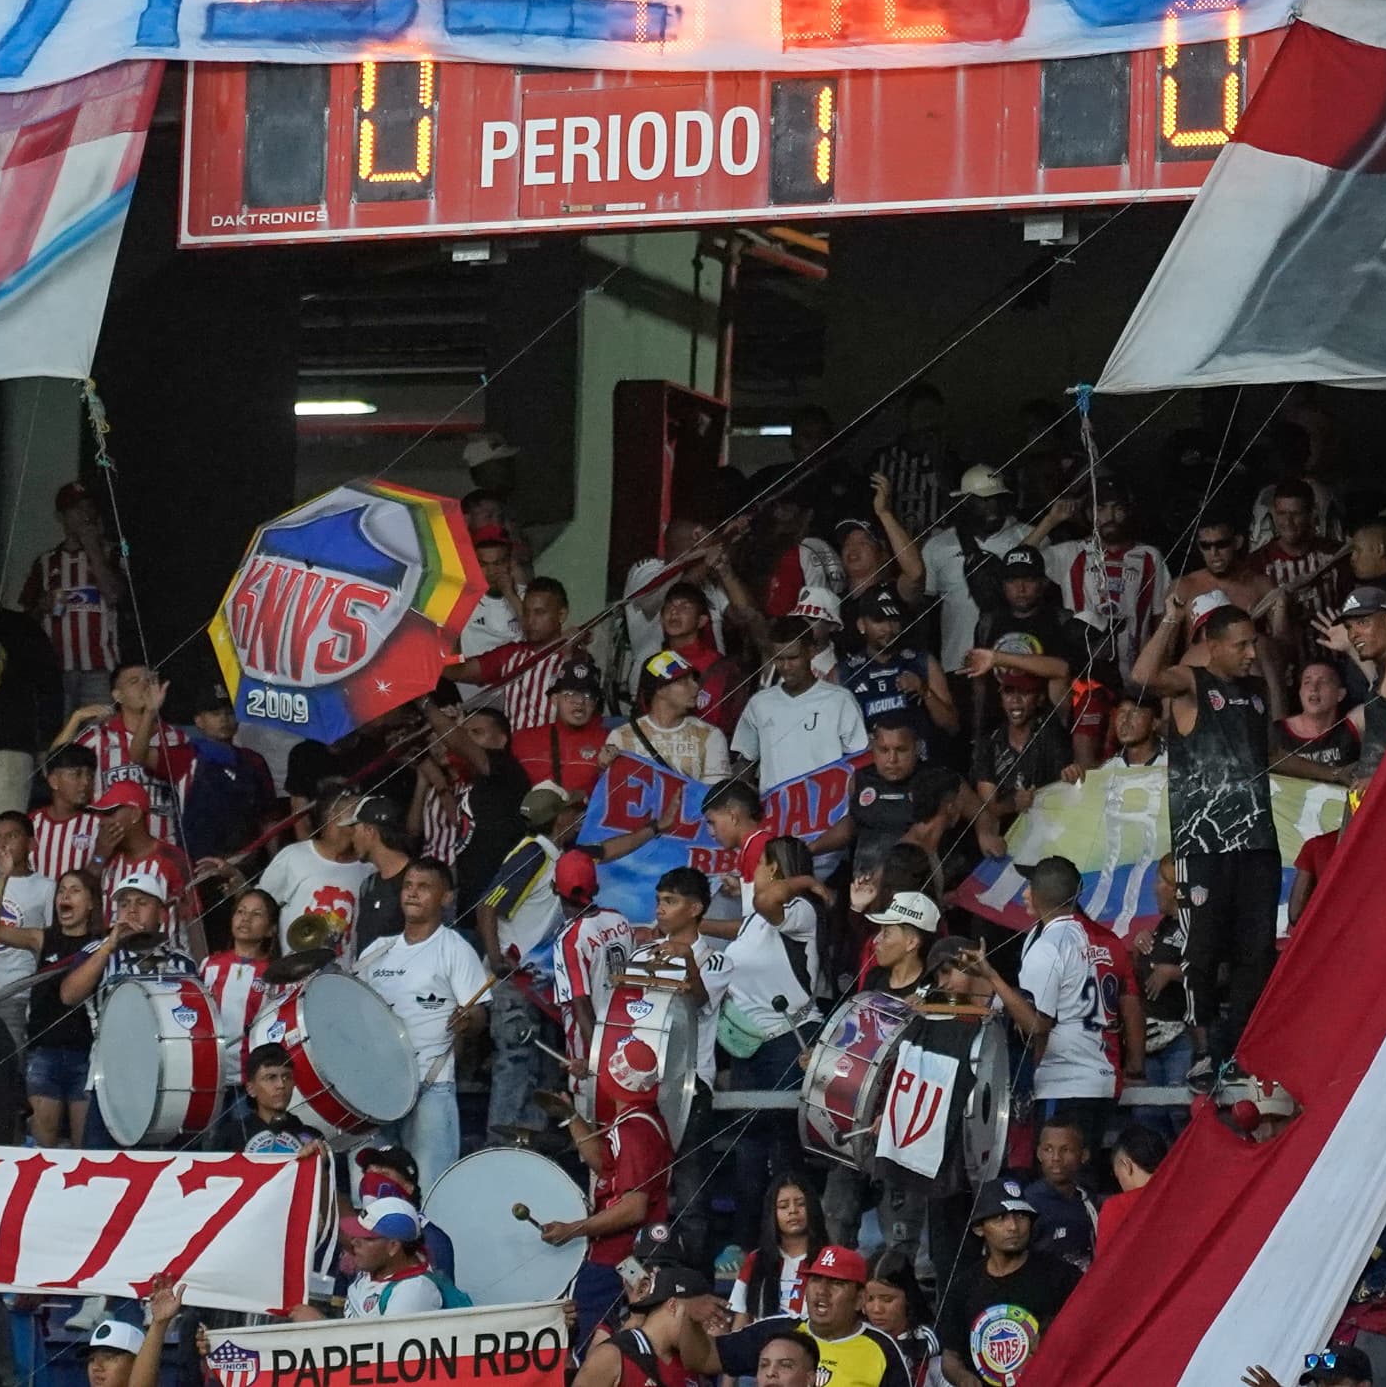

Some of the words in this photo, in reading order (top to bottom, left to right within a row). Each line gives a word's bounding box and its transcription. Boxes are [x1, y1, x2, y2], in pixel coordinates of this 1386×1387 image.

[481, 105, 761, 190] PERIODO
[816, 85, 833, 186] 1
[210, 210, 329, 228] DAKTRONICS
[231, 554, 393, 679] KNVS
[245, 685, 311, 725] 2009
[804, 711, 820, 732] J
[868, 695, 905, 716] AGUILA
[601, 754, 702, 841] EL
[271, 1336, 459, 1387] PAPELON
[473, 1325, 562, 1379] RBO
